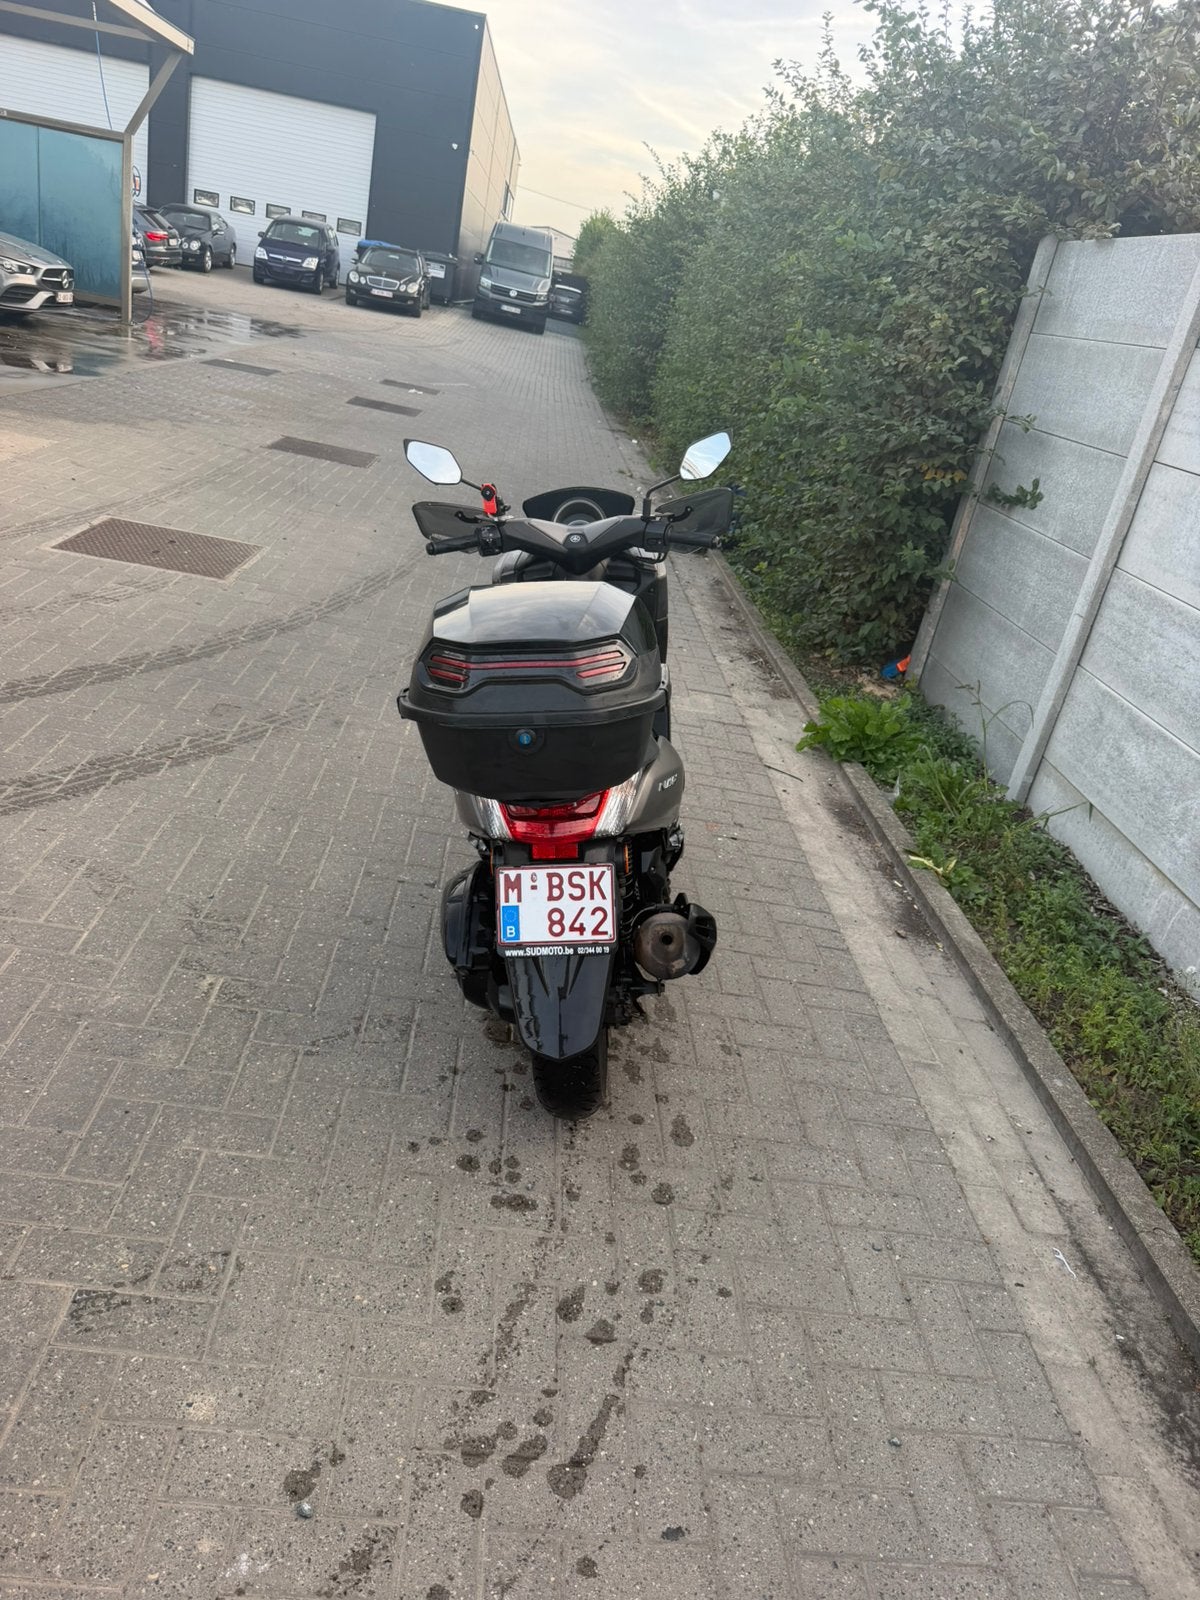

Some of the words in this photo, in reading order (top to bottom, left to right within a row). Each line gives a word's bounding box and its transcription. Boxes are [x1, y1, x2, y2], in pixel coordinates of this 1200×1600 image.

[546, 871, 607, 901] BSK
[507, 926, 516, 938] B
[548, 907, 608, 937] 842
[505, 946, 574, 957] www.SUDMOTO.be
